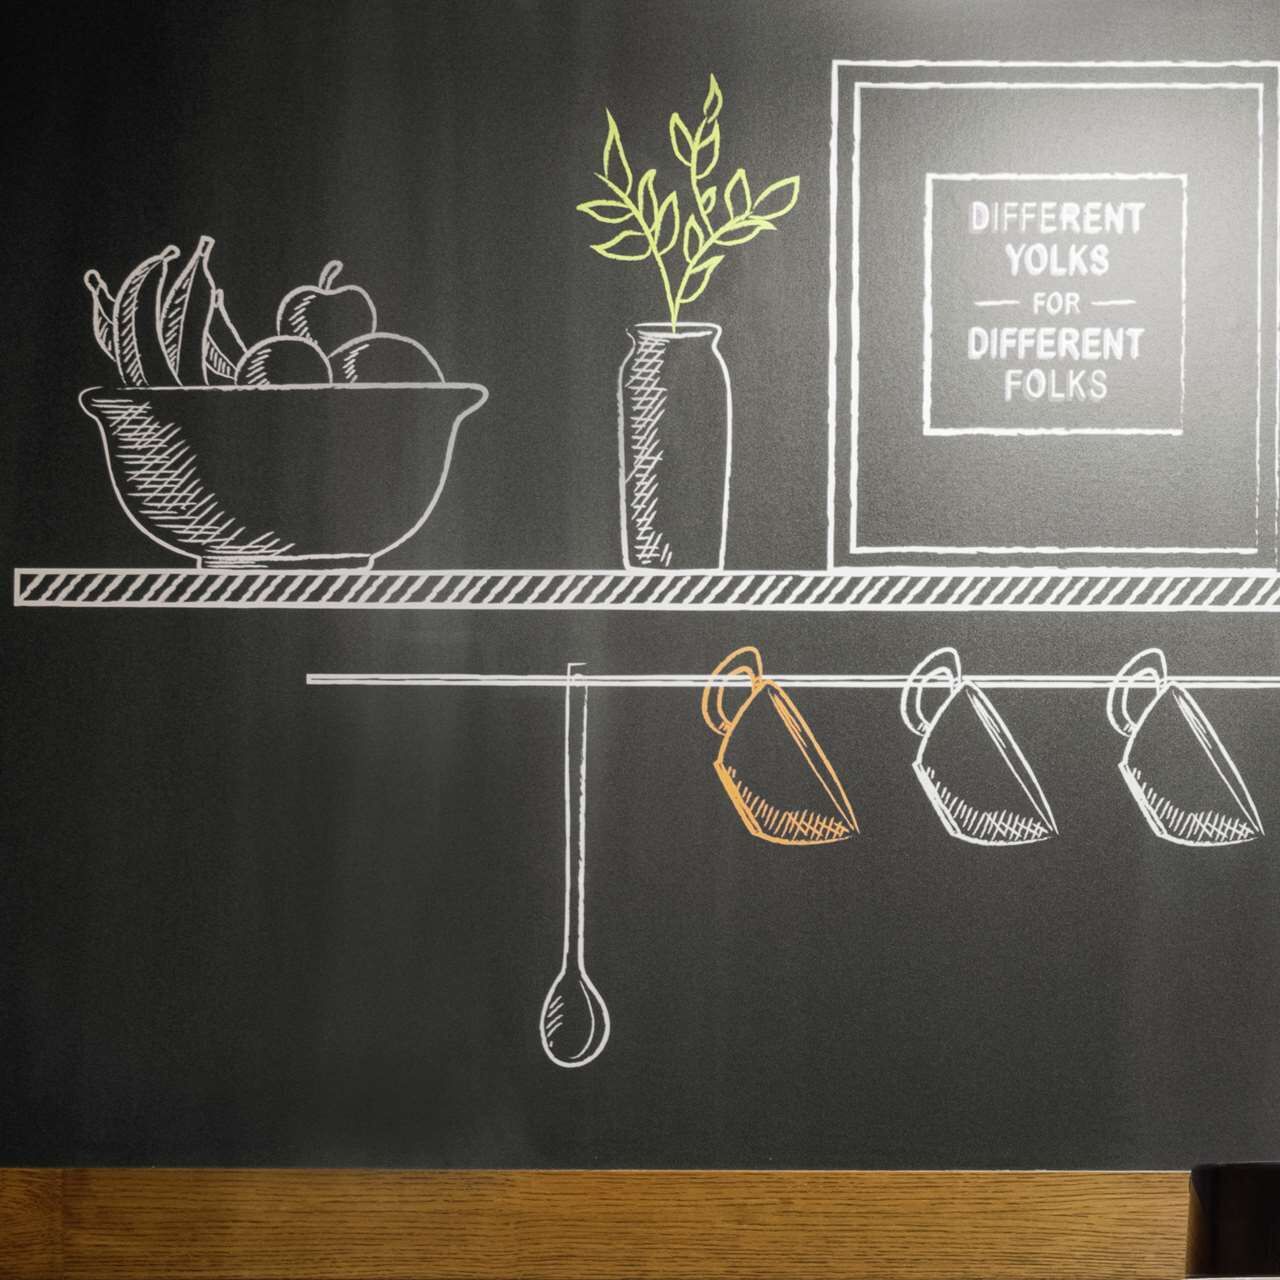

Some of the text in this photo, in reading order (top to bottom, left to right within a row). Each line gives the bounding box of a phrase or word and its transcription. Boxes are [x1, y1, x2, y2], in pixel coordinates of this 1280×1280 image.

[969, 201, 1146, 234] DIFFERENT
[1004, 243, 1109, 276] YOLKS
[1032, 291, 1080, 315] FOR
[967, 326, 1145, 360] DIFFERENT
[1003, 368, 1108, 401] FOLKS
